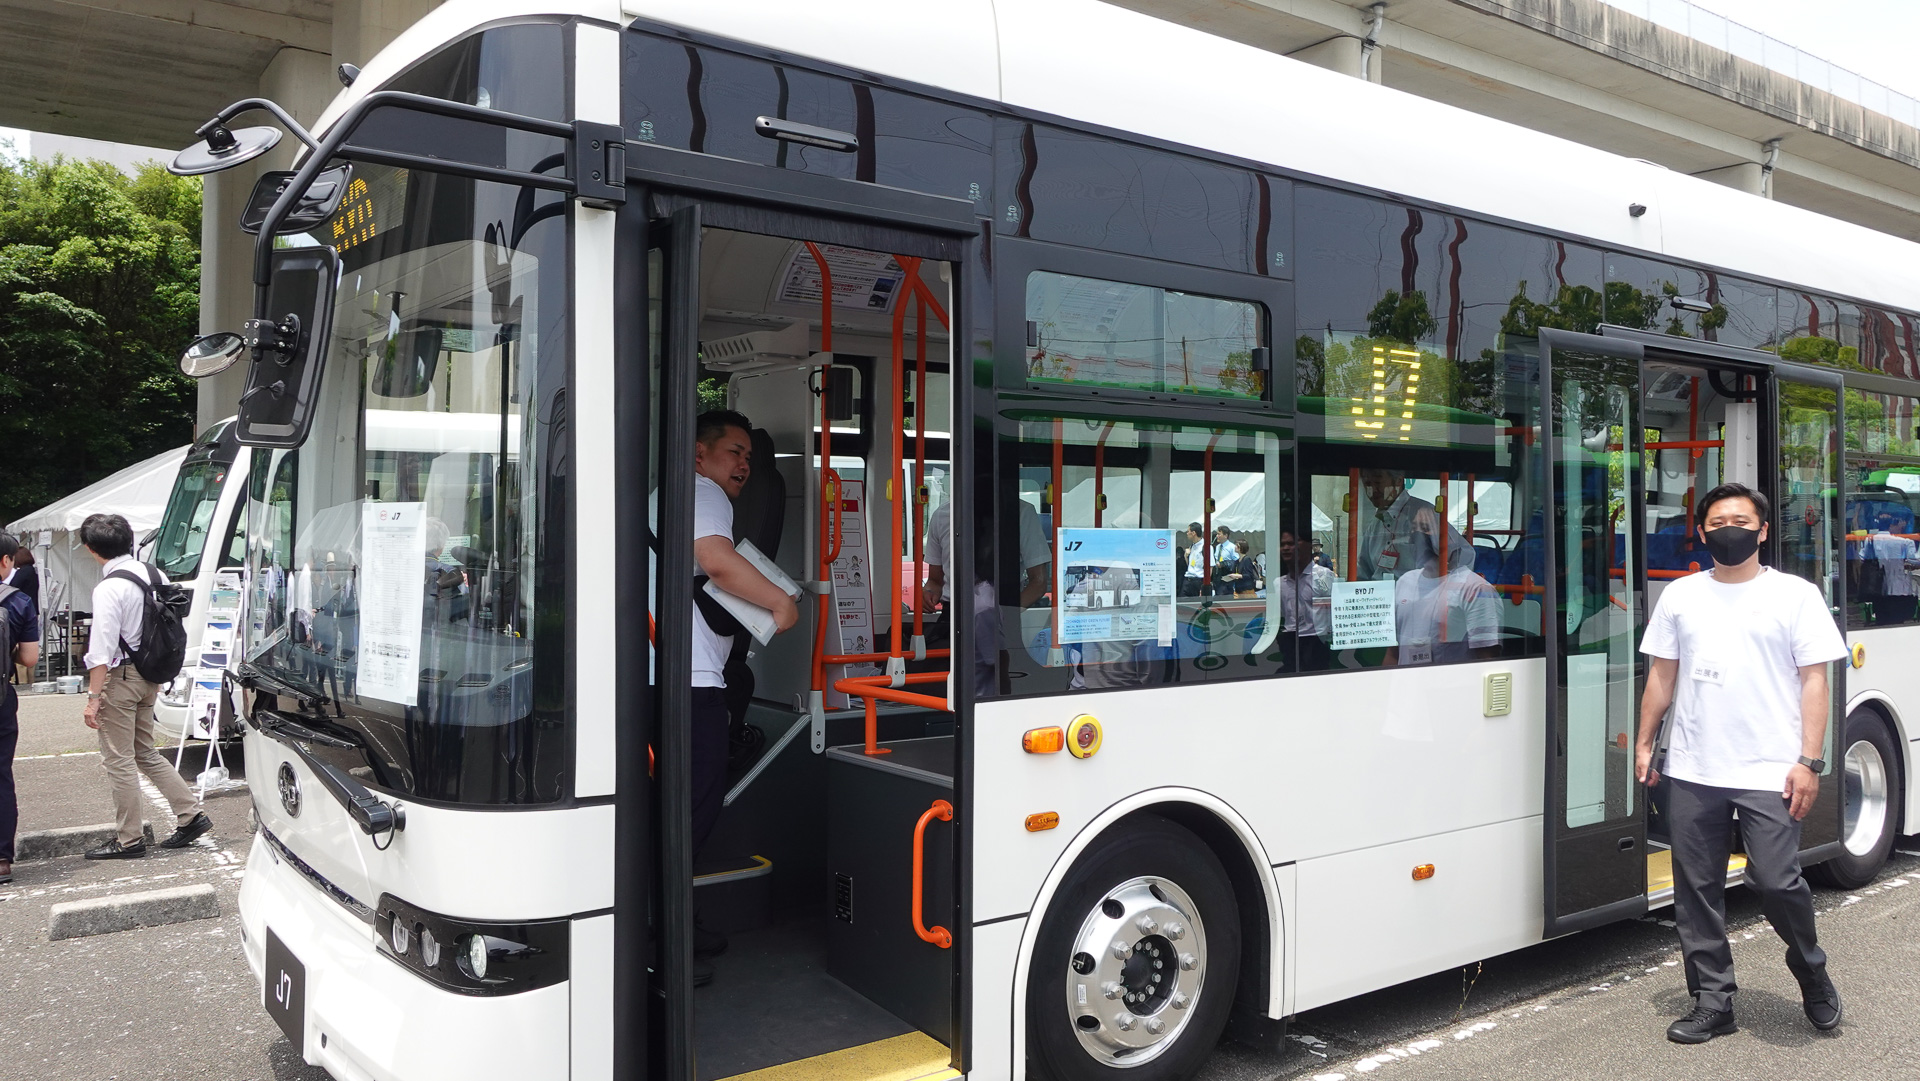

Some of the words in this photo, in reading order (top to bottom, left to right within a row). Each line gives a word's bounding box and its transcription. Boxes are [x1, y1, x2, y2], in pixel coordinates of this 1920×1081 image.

[1351, 346, 1421, 441] J7
[391, 512, 401, 521] J7
[1064, 541, 1083, 552] J7
[276, 969, 292, 1010] J7
